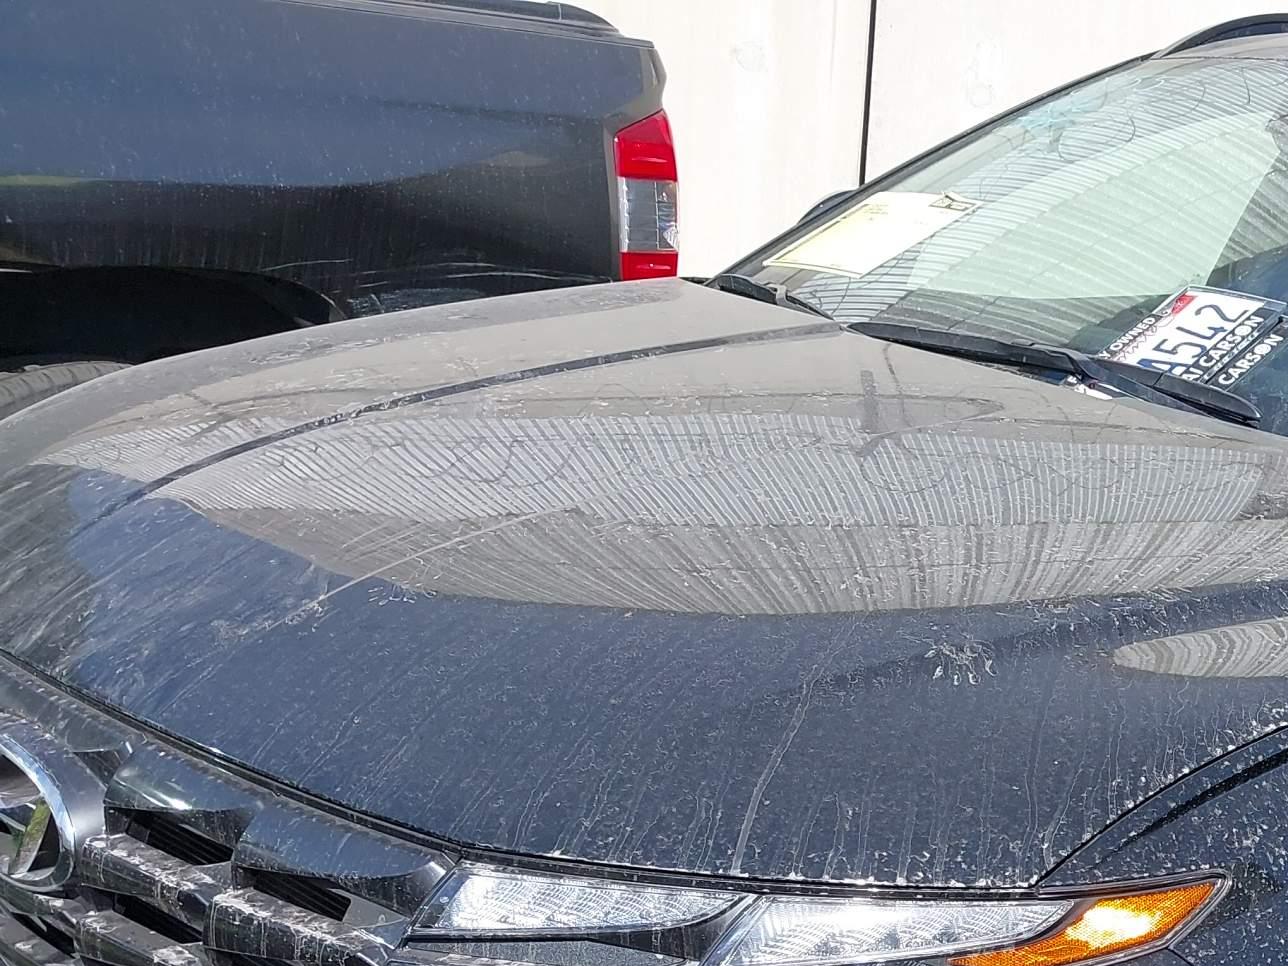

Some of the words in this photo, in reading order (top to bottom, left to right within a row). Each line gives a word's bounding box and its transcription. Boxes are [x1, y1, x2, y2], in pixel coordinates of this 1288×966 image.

[1109, 317, 1157, 350] OWNED
[1199, 315, 1265, 367] CARSON
[1218, 333, 1284, 385] CARSON
